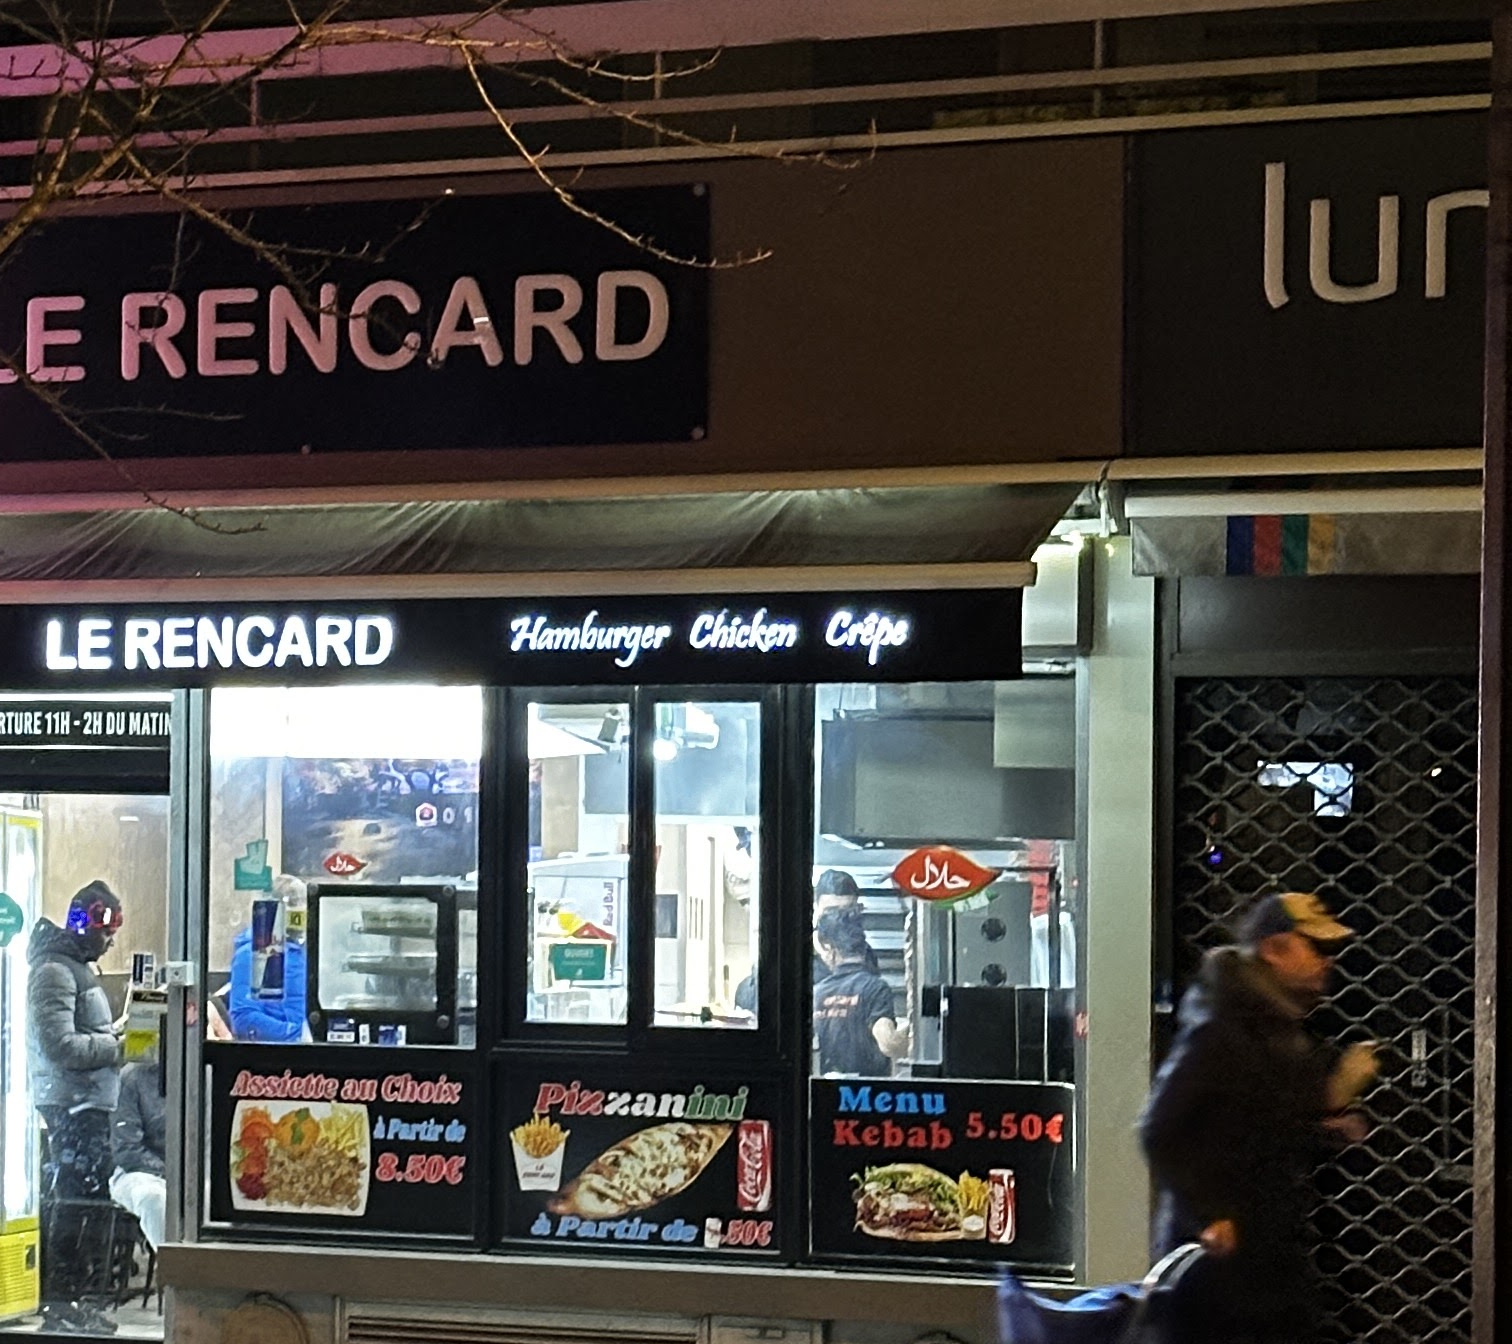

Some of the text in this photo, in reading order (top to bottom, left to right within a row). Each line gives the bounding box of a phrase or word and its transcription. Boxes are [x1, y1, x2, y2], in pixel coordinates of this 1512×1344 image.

[121, 269, 670, 382] RENCARD
[45, 617, 112, 671] LE
[124, 614, 394, 671] RENCARD
[510, 610, 672, 666] Hamburger
[688, 607, 797, 652] Chicken
[824, 608, 911, 665] Crêpe
[44, 711, 71, 735] 11H
[83, 711, 103, 735] 2H
[106, 712, 125, 735] DU
[910, 854, 972, 891] حلال
[229, 1069, 463, 1104] Assiette au Choix
[533, 1080, 750, 1121] Pizzanini
[838, 1085, 947, 1116] Menu
[373, 1115, 467, 1143] à Partir de
[832, 1111, 1065, 1150] Kebab 5.50€
[375, 1152, 466, 1185] 8.50€
[530, 1211, 552, 1236] à
[555, 1216, 659, 1241] Partir
[661, 1219, 699, 1242] de
